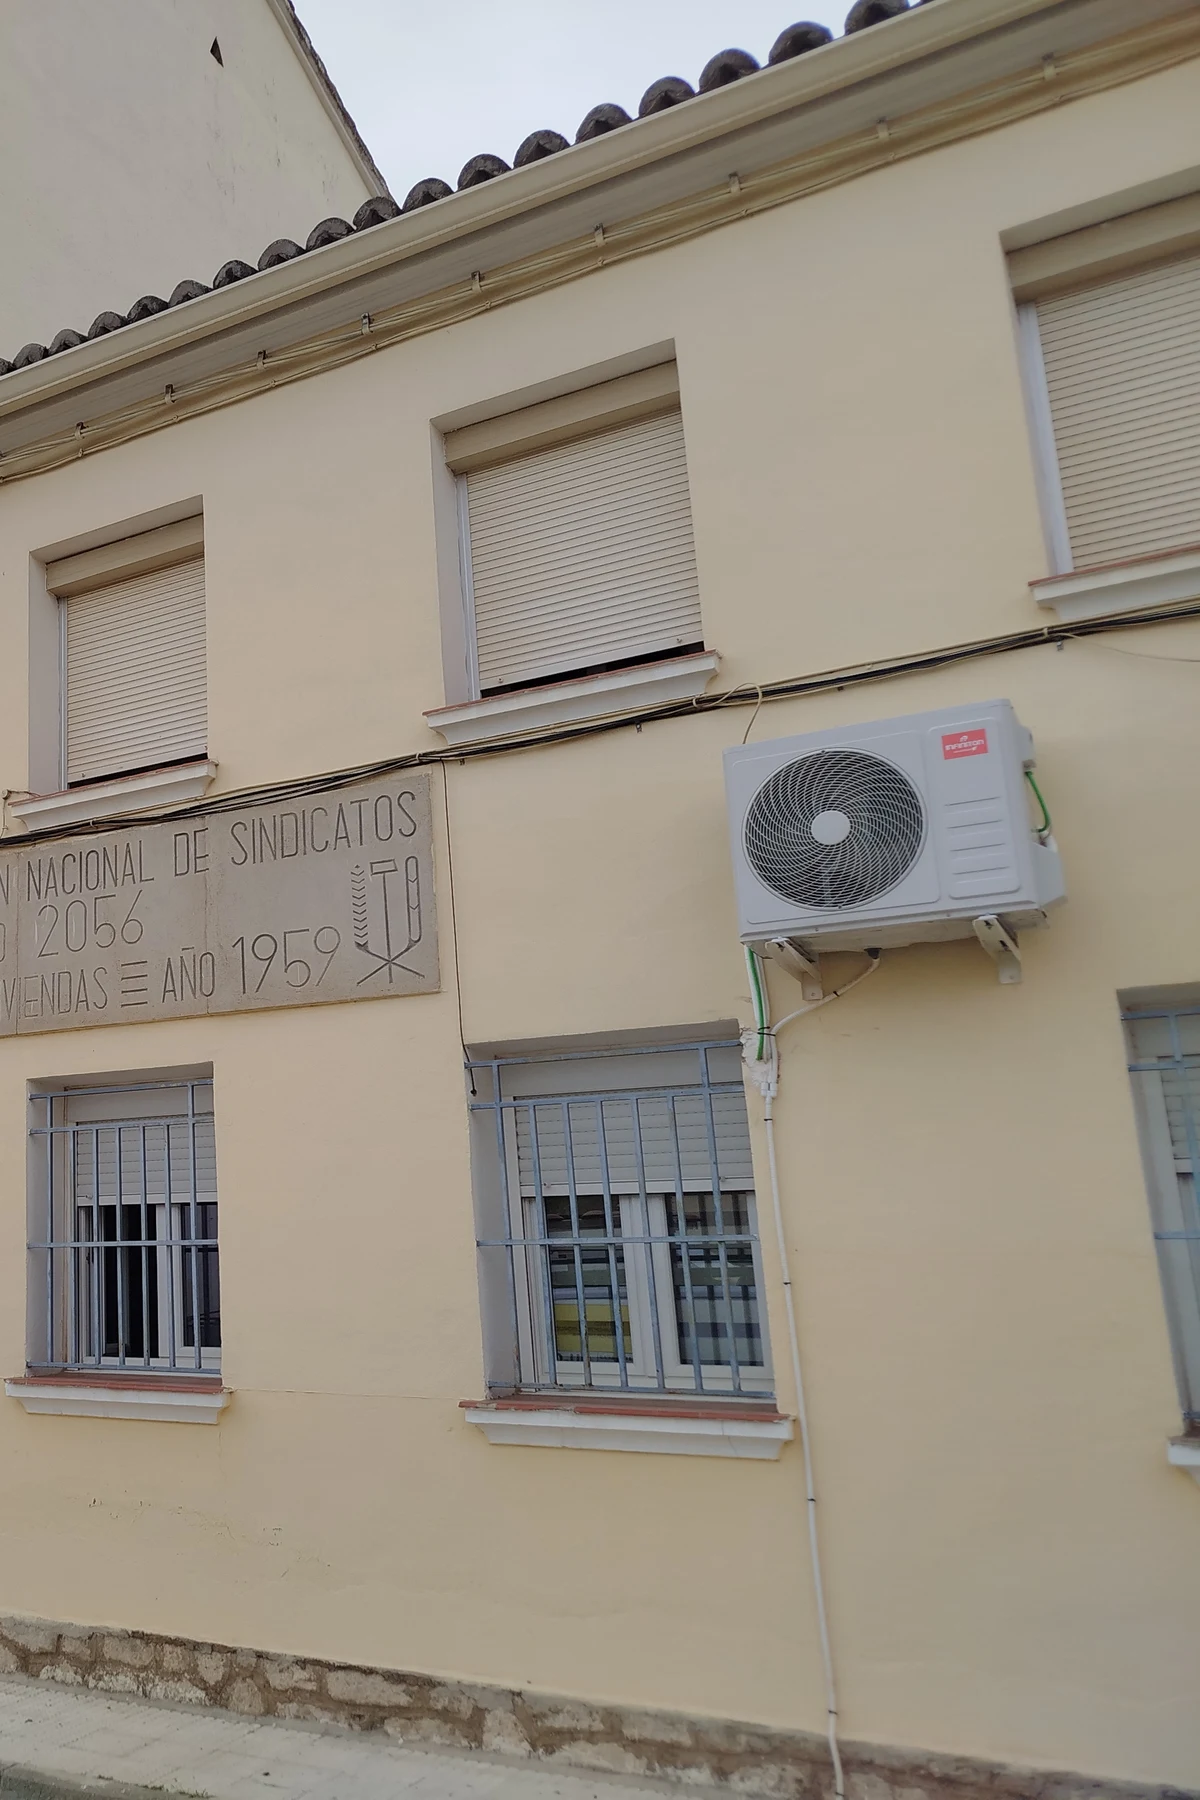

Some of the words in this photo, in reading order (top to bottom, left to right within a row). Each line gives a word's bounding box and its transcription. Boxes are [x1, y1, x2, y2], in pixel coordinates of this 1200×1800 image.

[27, 840, 154, 901] NACIONAL
[173, 827, 209, 877] DE
[230, 790, 417, 866] SINDICATOS
[38, 889, 144, 958] 2056
[162, 946, 215, 1003] AÑO
[232, 926, 341, 994] 1959
